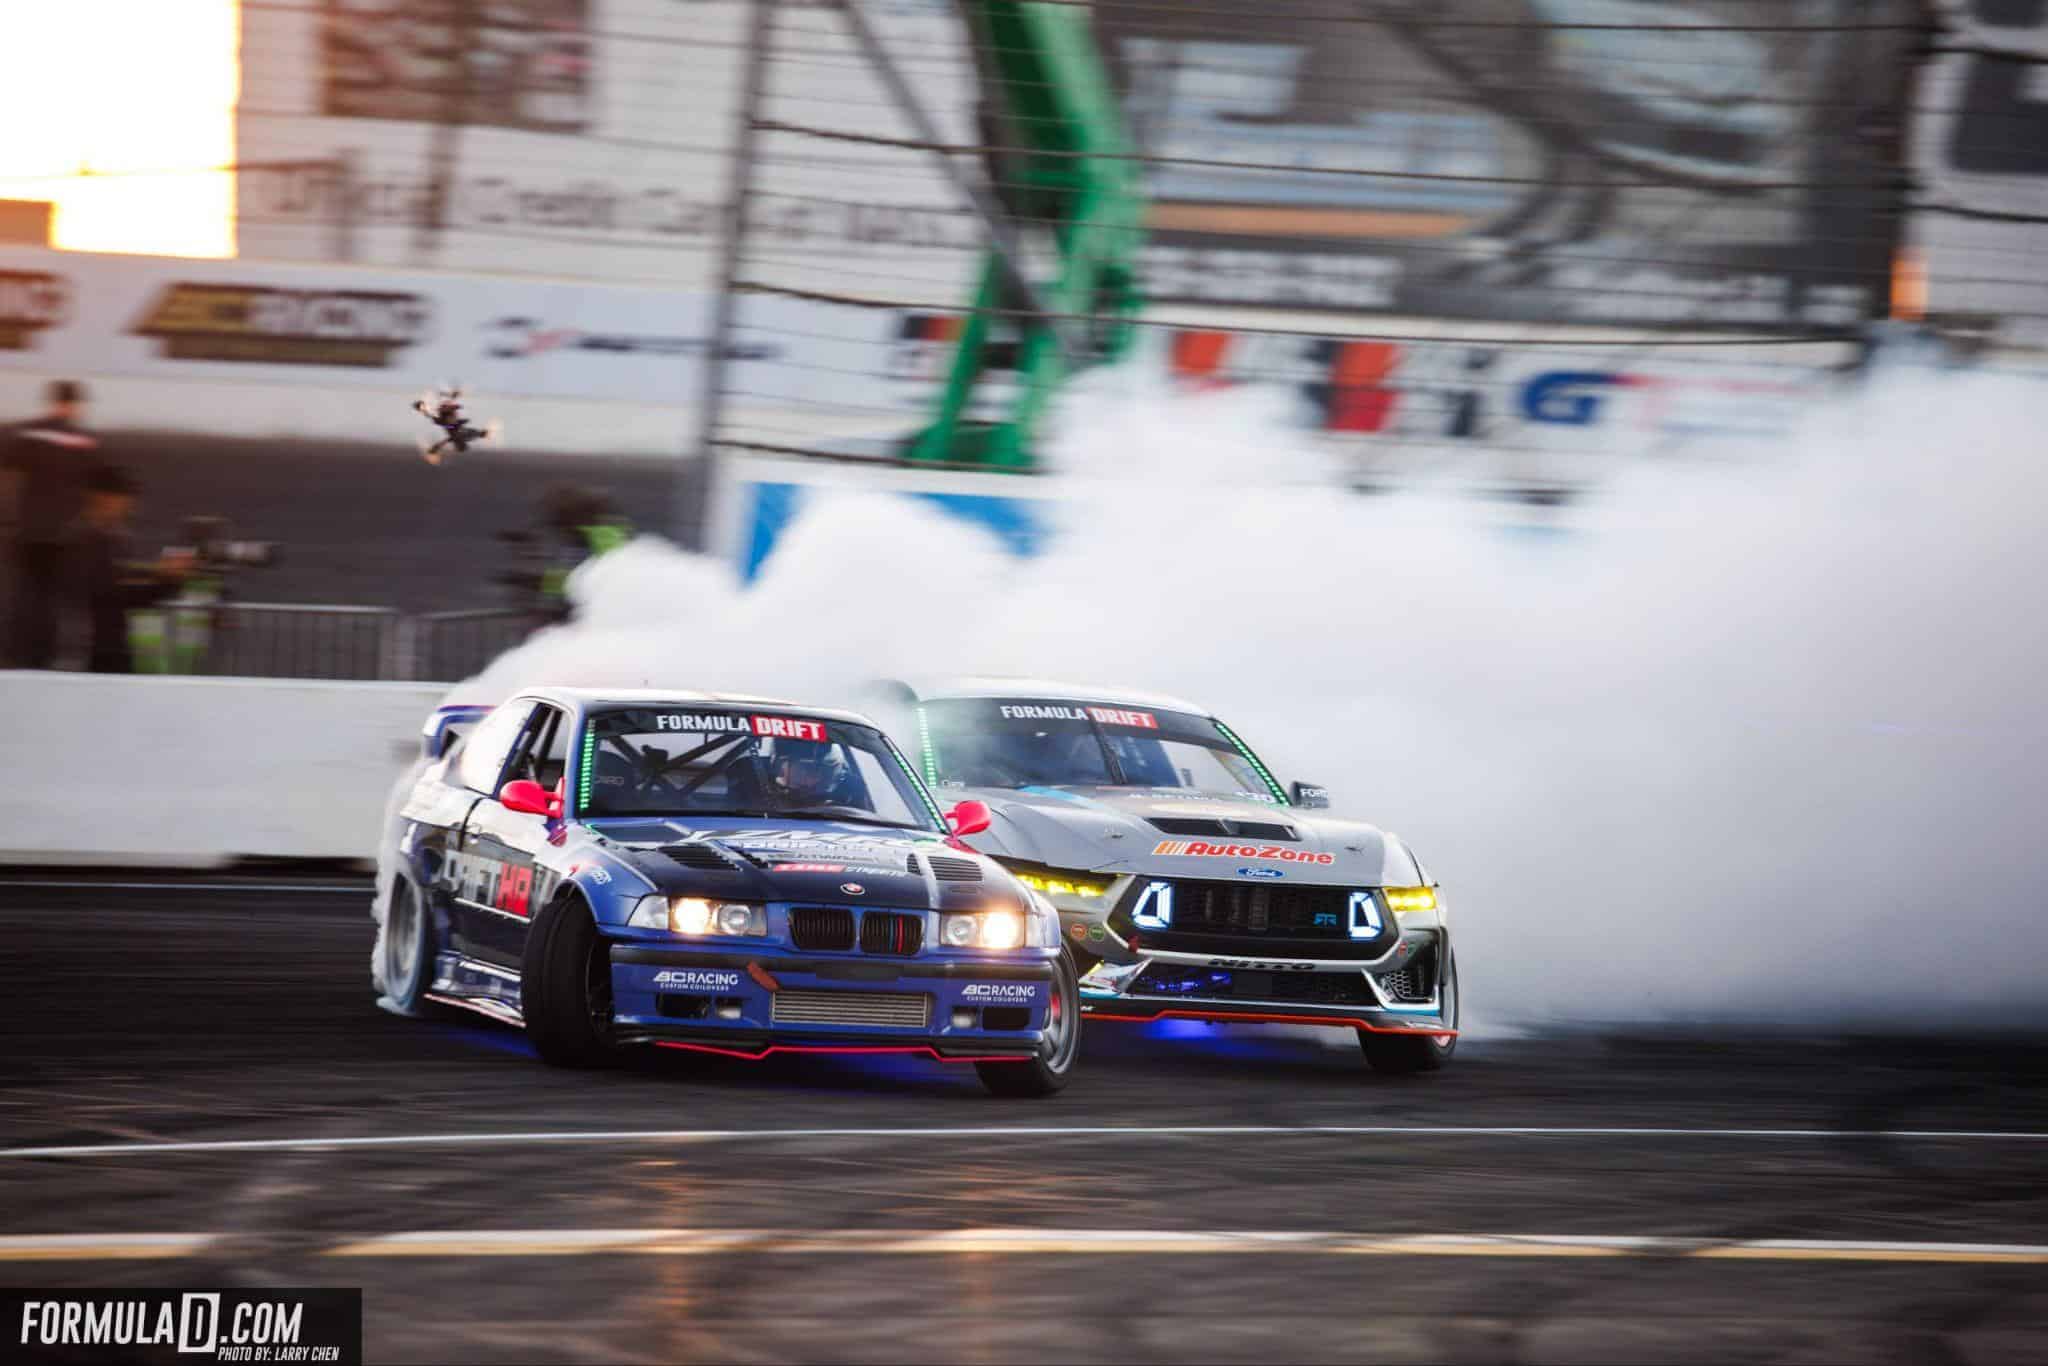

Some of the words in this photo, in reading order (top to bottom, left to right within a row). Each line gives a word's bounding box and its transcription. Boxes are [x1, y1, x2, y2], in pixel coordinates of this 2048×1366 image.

[656, 715, 750, 731] FORMULA
[755, 717, 821, 740] DRIFT
[1000, 705, 1089, 720] FORMULA
[1090, 709, 1152, 727] DRIFT
[1183, 841, 1336, 865] AutoZone
